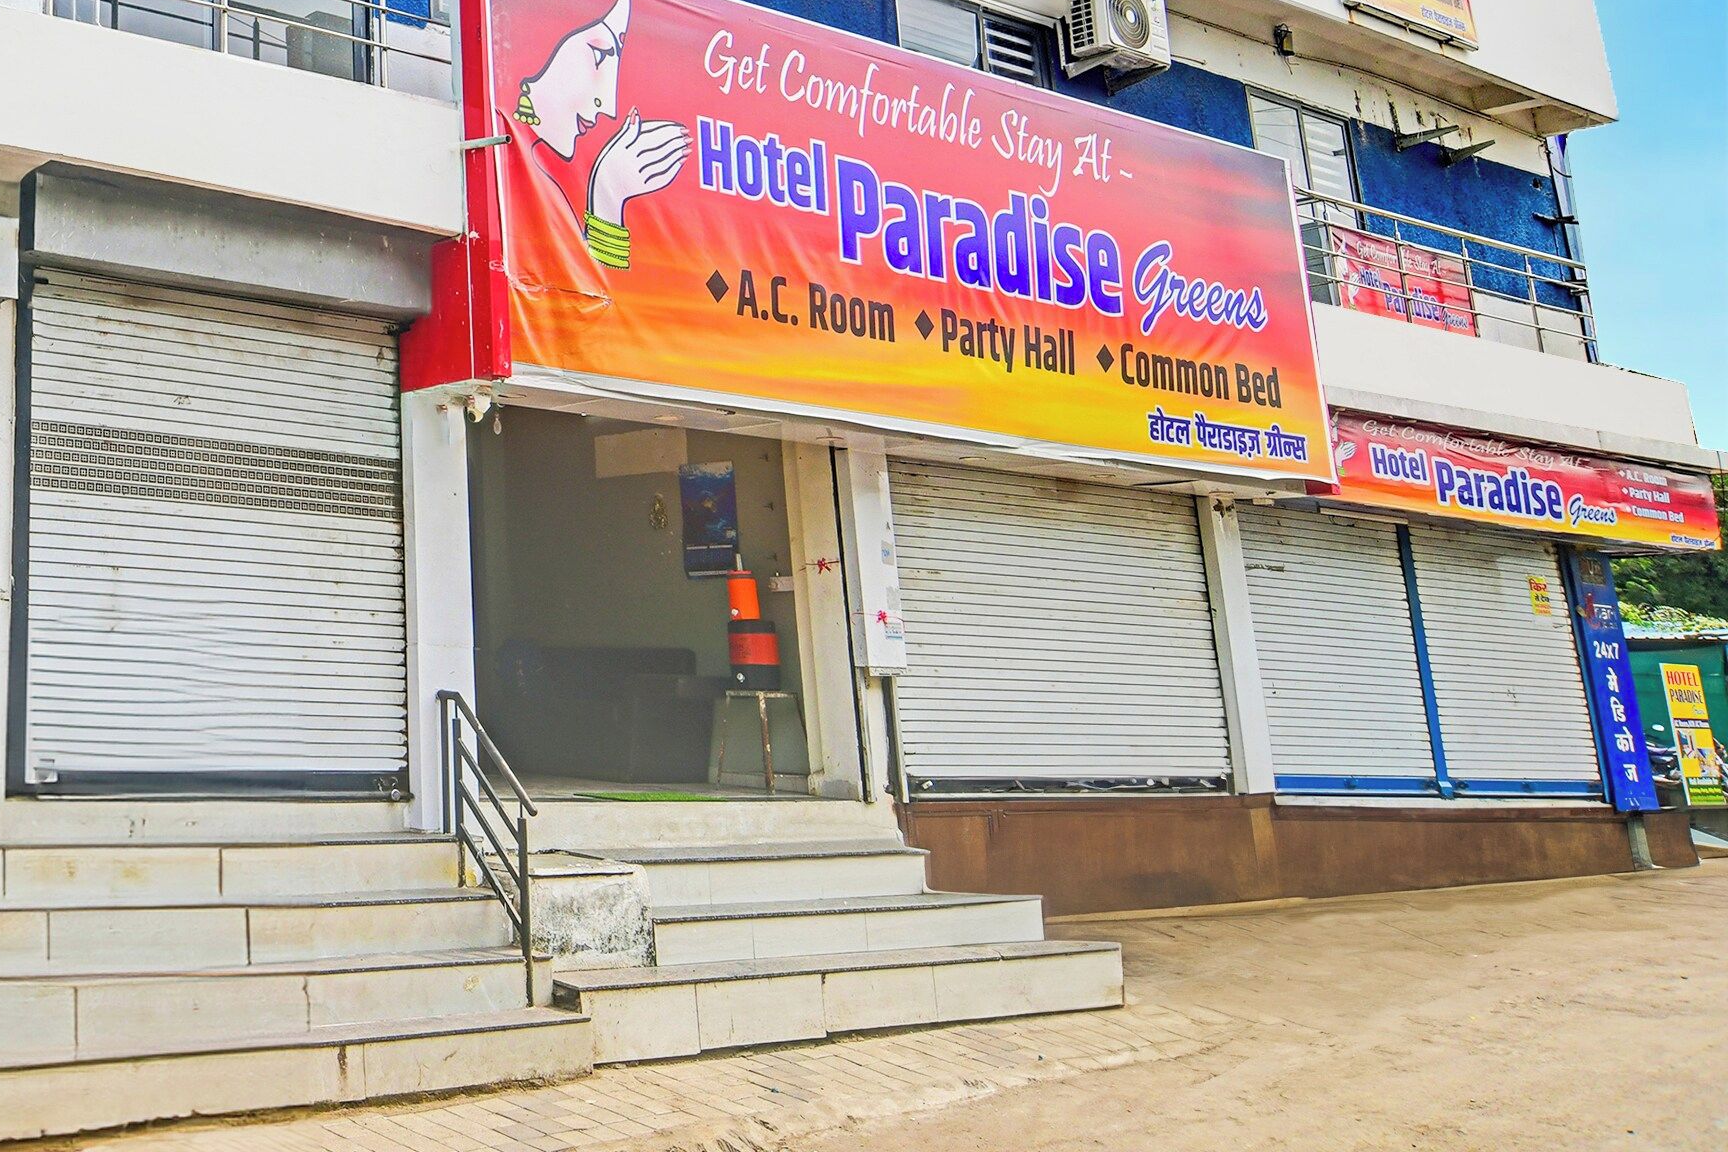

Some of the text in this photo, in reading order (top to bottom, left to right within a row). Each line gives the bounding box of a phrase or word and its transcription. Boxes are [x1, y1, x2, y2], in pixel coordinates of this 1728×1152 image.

[703, 28, 770, 96] Get
[778, 48, 983, 151] Comfortable
[991, 109, 1064, 198] Stay
[1073, 131, 1113, 184] At
[696, 115, 1268, 336] Hotel Paradise Greens
[1357, 241, 1371, 258] Get
[1359, 267, 1381, 289] Hotel
[736, 268, 1282, 409] A.C. Room Party Hall Common Bed
[1148, 407, 1190, 445] होटल
[1264, 424, 1308, 461] ग्रीन्स
[1362, 419, 1399, 438] Get
[1401, 425, 1511, 459] Comfortable
[1517, 446, 1556, 469] Stay
[1369, 444, 1618, 527] Hotel Paradise Greens
[1643, 472, 1668, 486] Room
[1628, 486, 1670, 503] Party Hall
[1632, 505, 1685, 523] Common Bed
[1666, 671, 1700, 686] HOTEL
[1669, 689, 1703, 704] PARADISE
